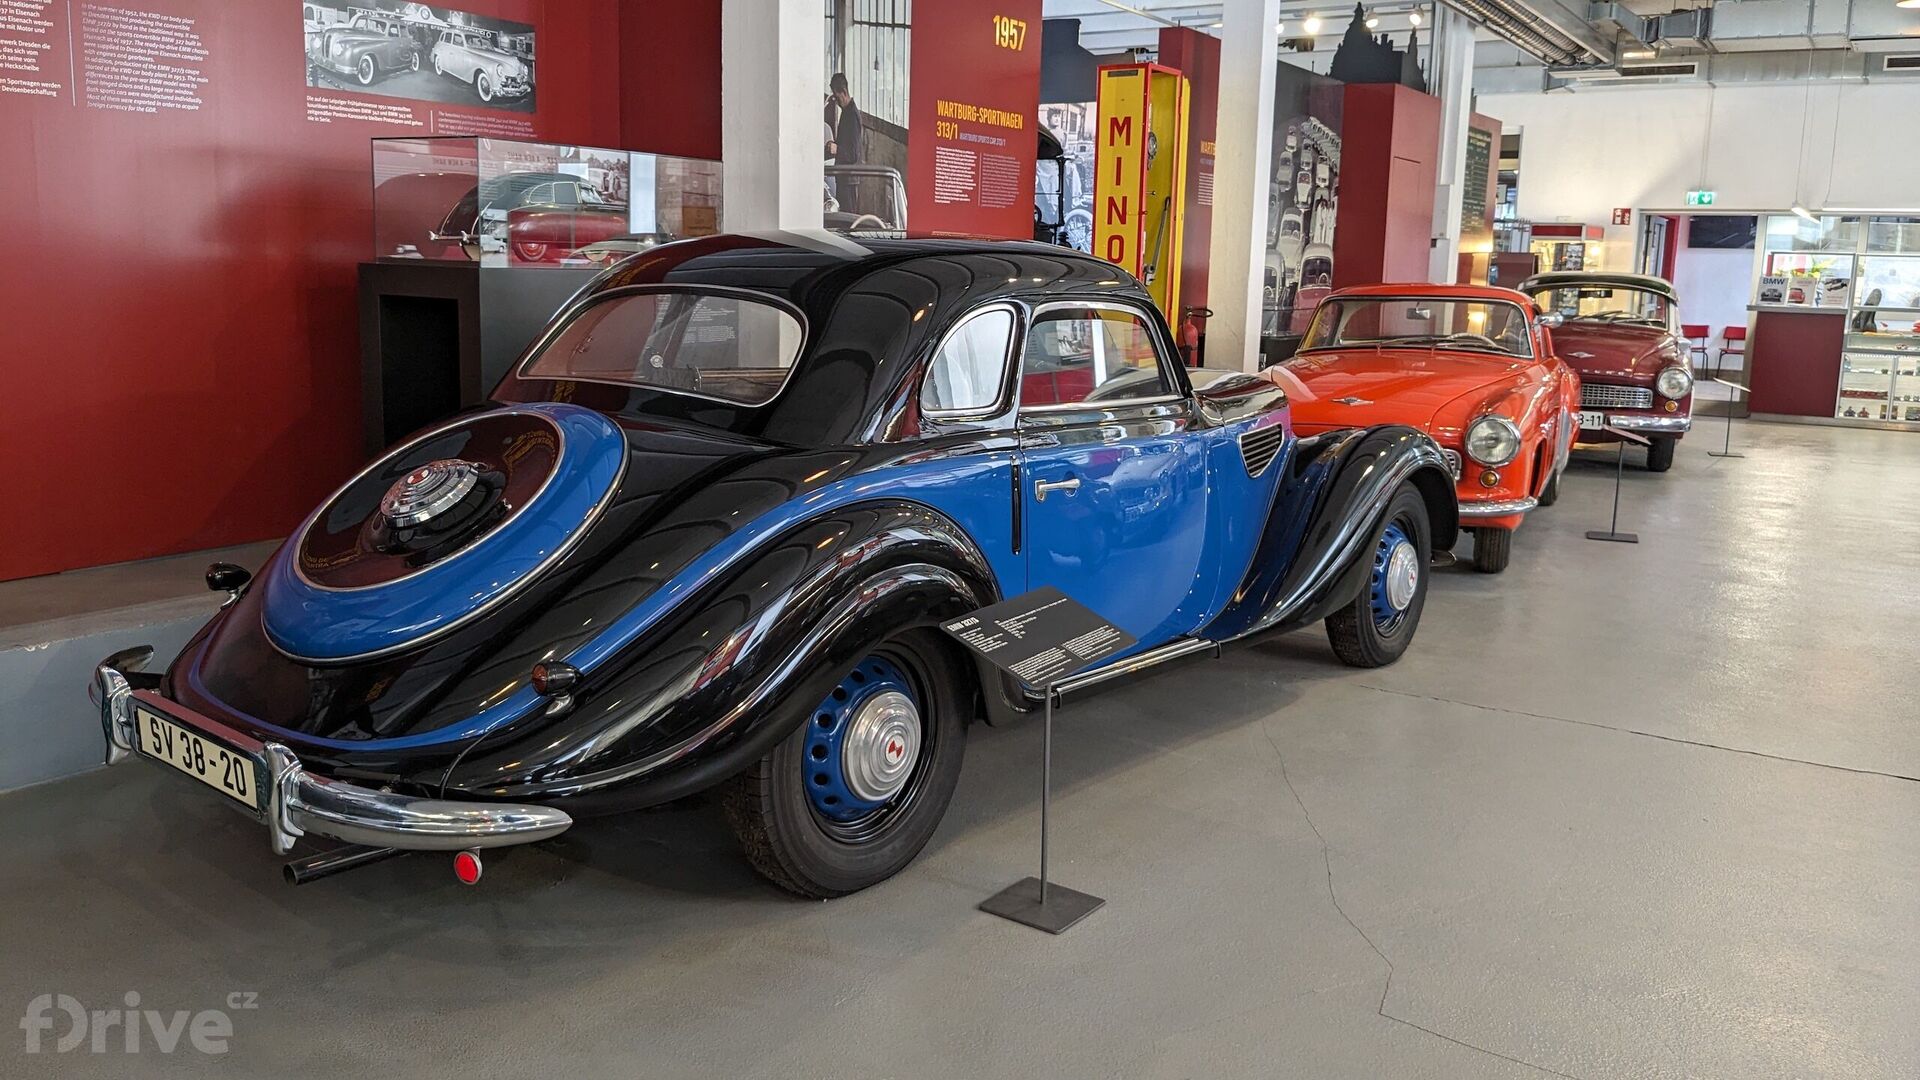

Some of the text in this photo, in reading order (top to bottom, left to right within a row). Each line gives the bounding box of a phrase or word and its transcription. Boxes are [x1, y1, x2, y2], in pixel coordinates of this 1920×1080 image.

[9, 0, 44, 10] traditioneller
[16, 9, 40, 17] Eisenach
[8, 16, 33, 24] Eisenach
[129, 18, 154, 27] producing
[164, 23, 190, 31] convertible
[133, 33, 160, 41] convertible
[993, 15, 1026, 51] 1957
[18, 40, 41, 48] Dresden
[5, 62, 40, 71] Heckscheibe
[7, 77, 40, 87] Sportwagen
[937, 99, 1023, 130] WARTBURG-SPORTWAGEN
[936, 120, 958, 140] 313/1
[1106, 116, 1132, 264] MINO
[150, 716, 247, 797] SV 38-20
